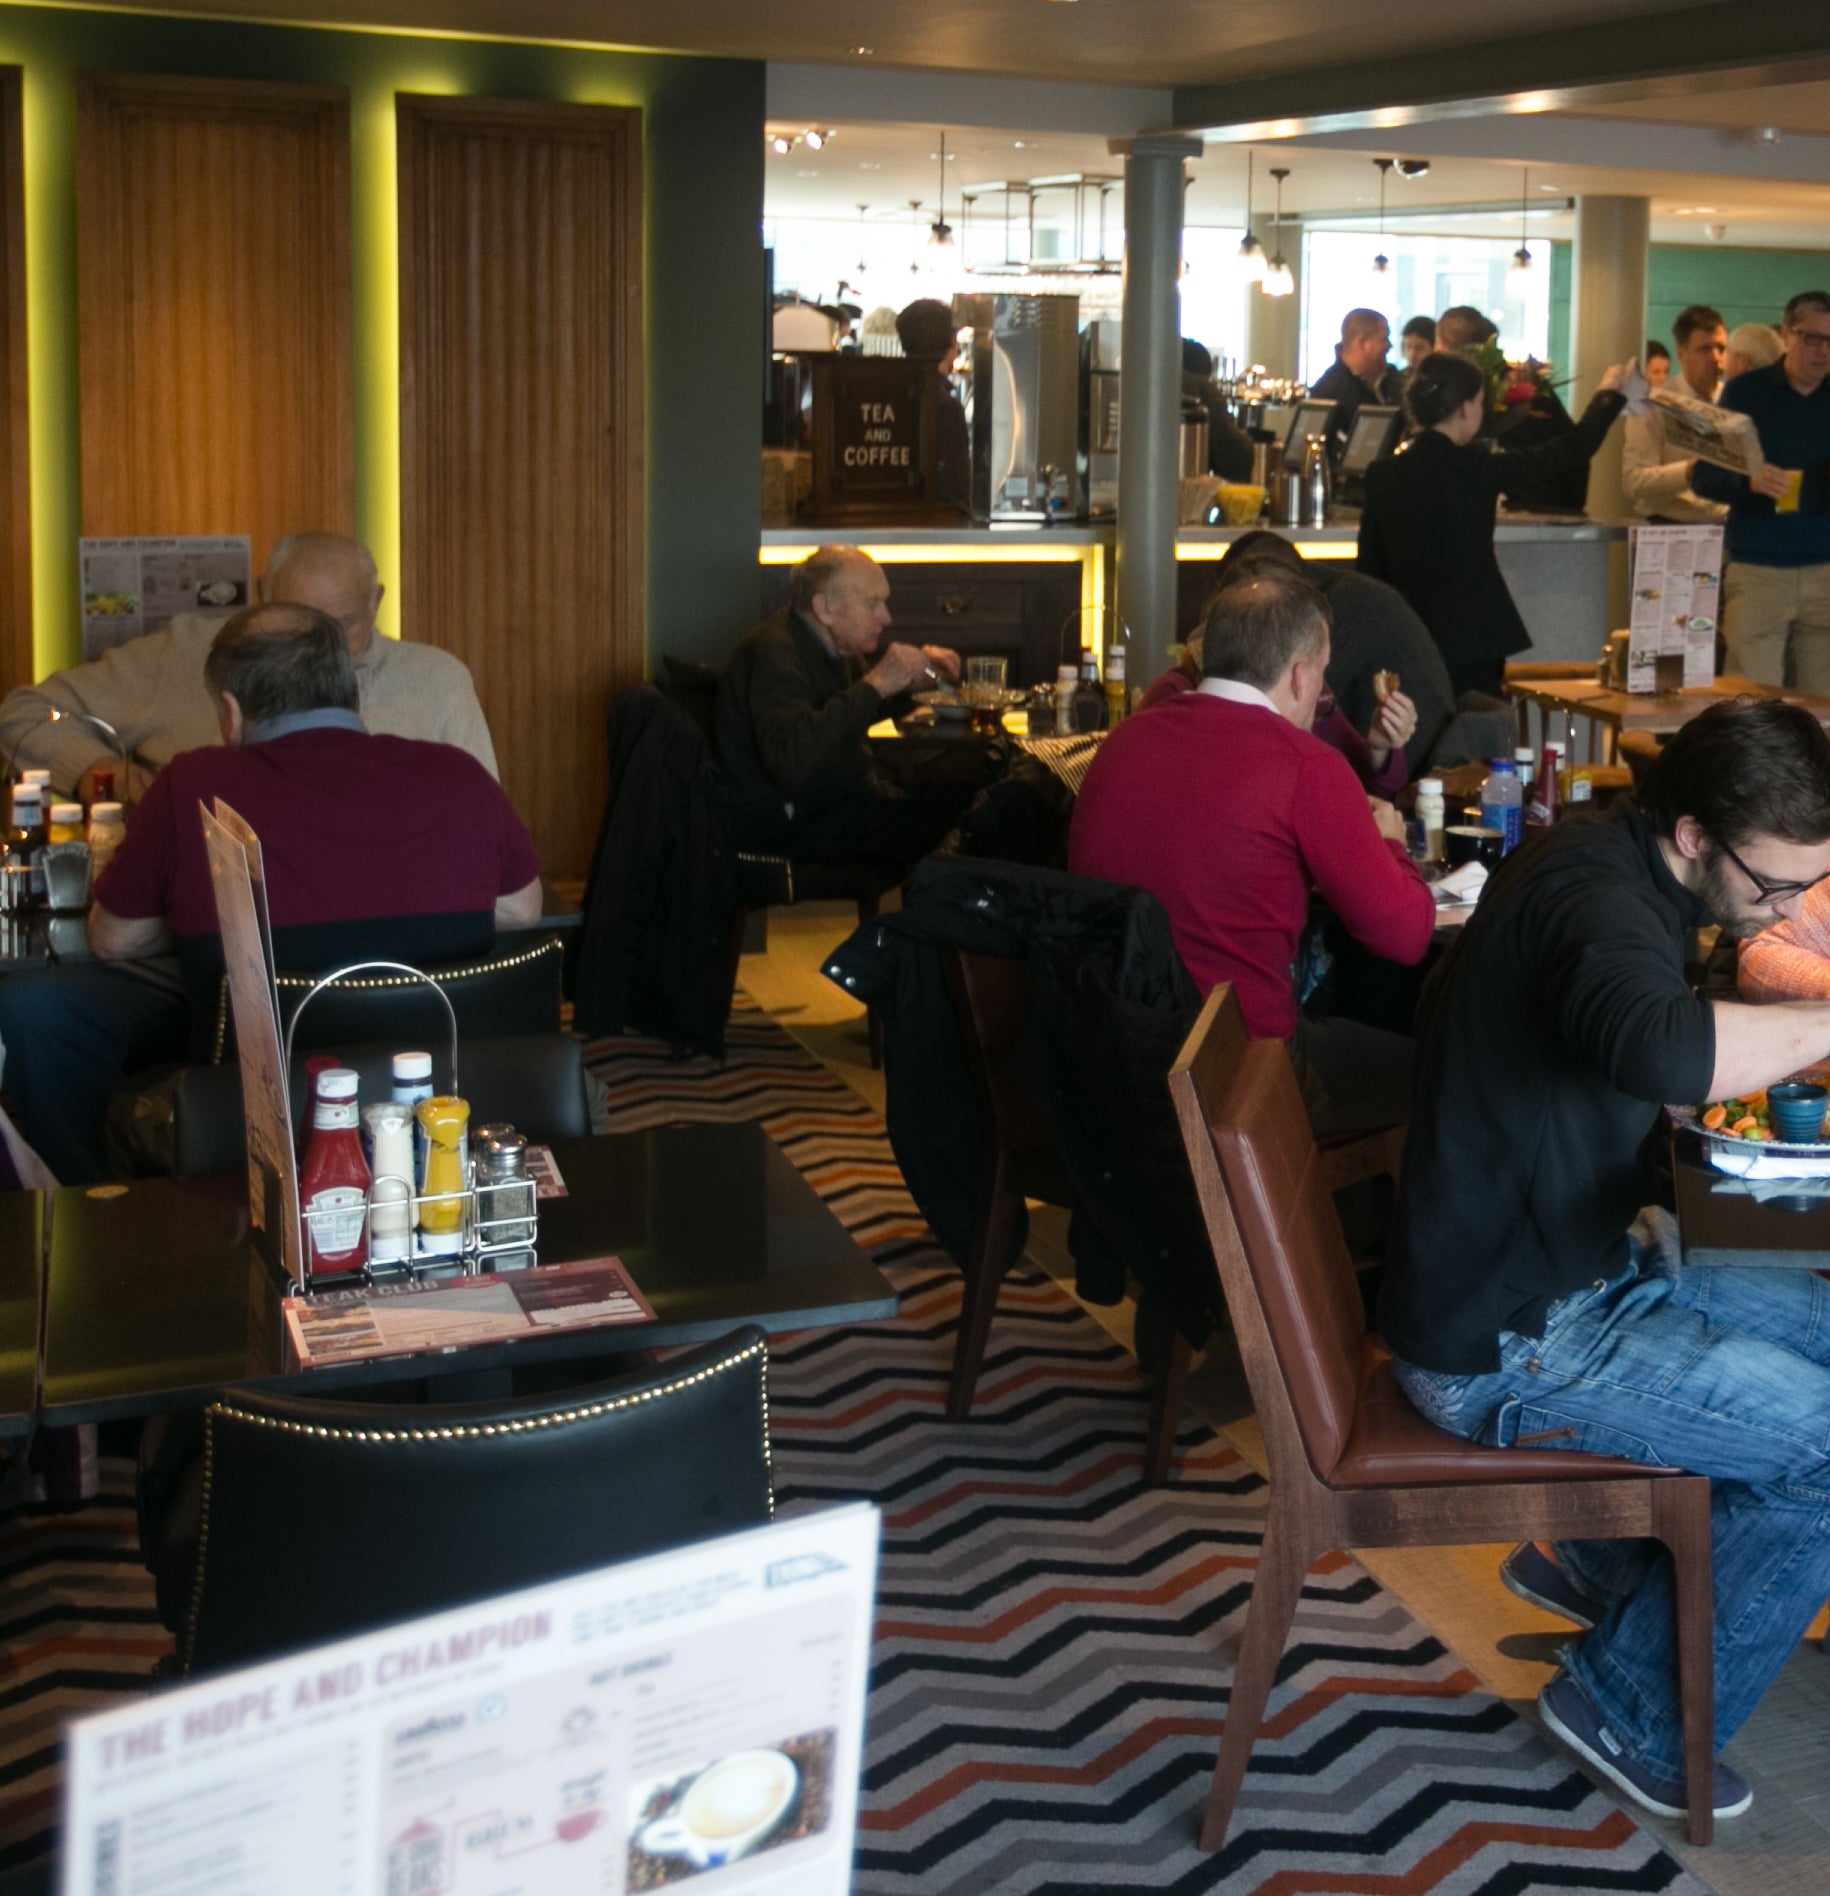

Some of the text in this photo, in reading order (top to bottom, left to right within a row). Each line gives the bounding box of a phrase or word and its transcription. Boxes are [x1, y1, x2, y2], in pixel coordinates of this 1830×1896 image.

[860, 403, 895, 423] TEA
[864, 428, 892, 442] AND
[844, 446, 911, 466] COFFEE
[378, 1280, 440, 1298] CLUB
[98, 1720, 171, 1772] THE
[183, 1692, 280, 1746] HOPE
[292, 1658, 367, 1708] AND
[375, 1607, 554, 1686] CHAMPION
